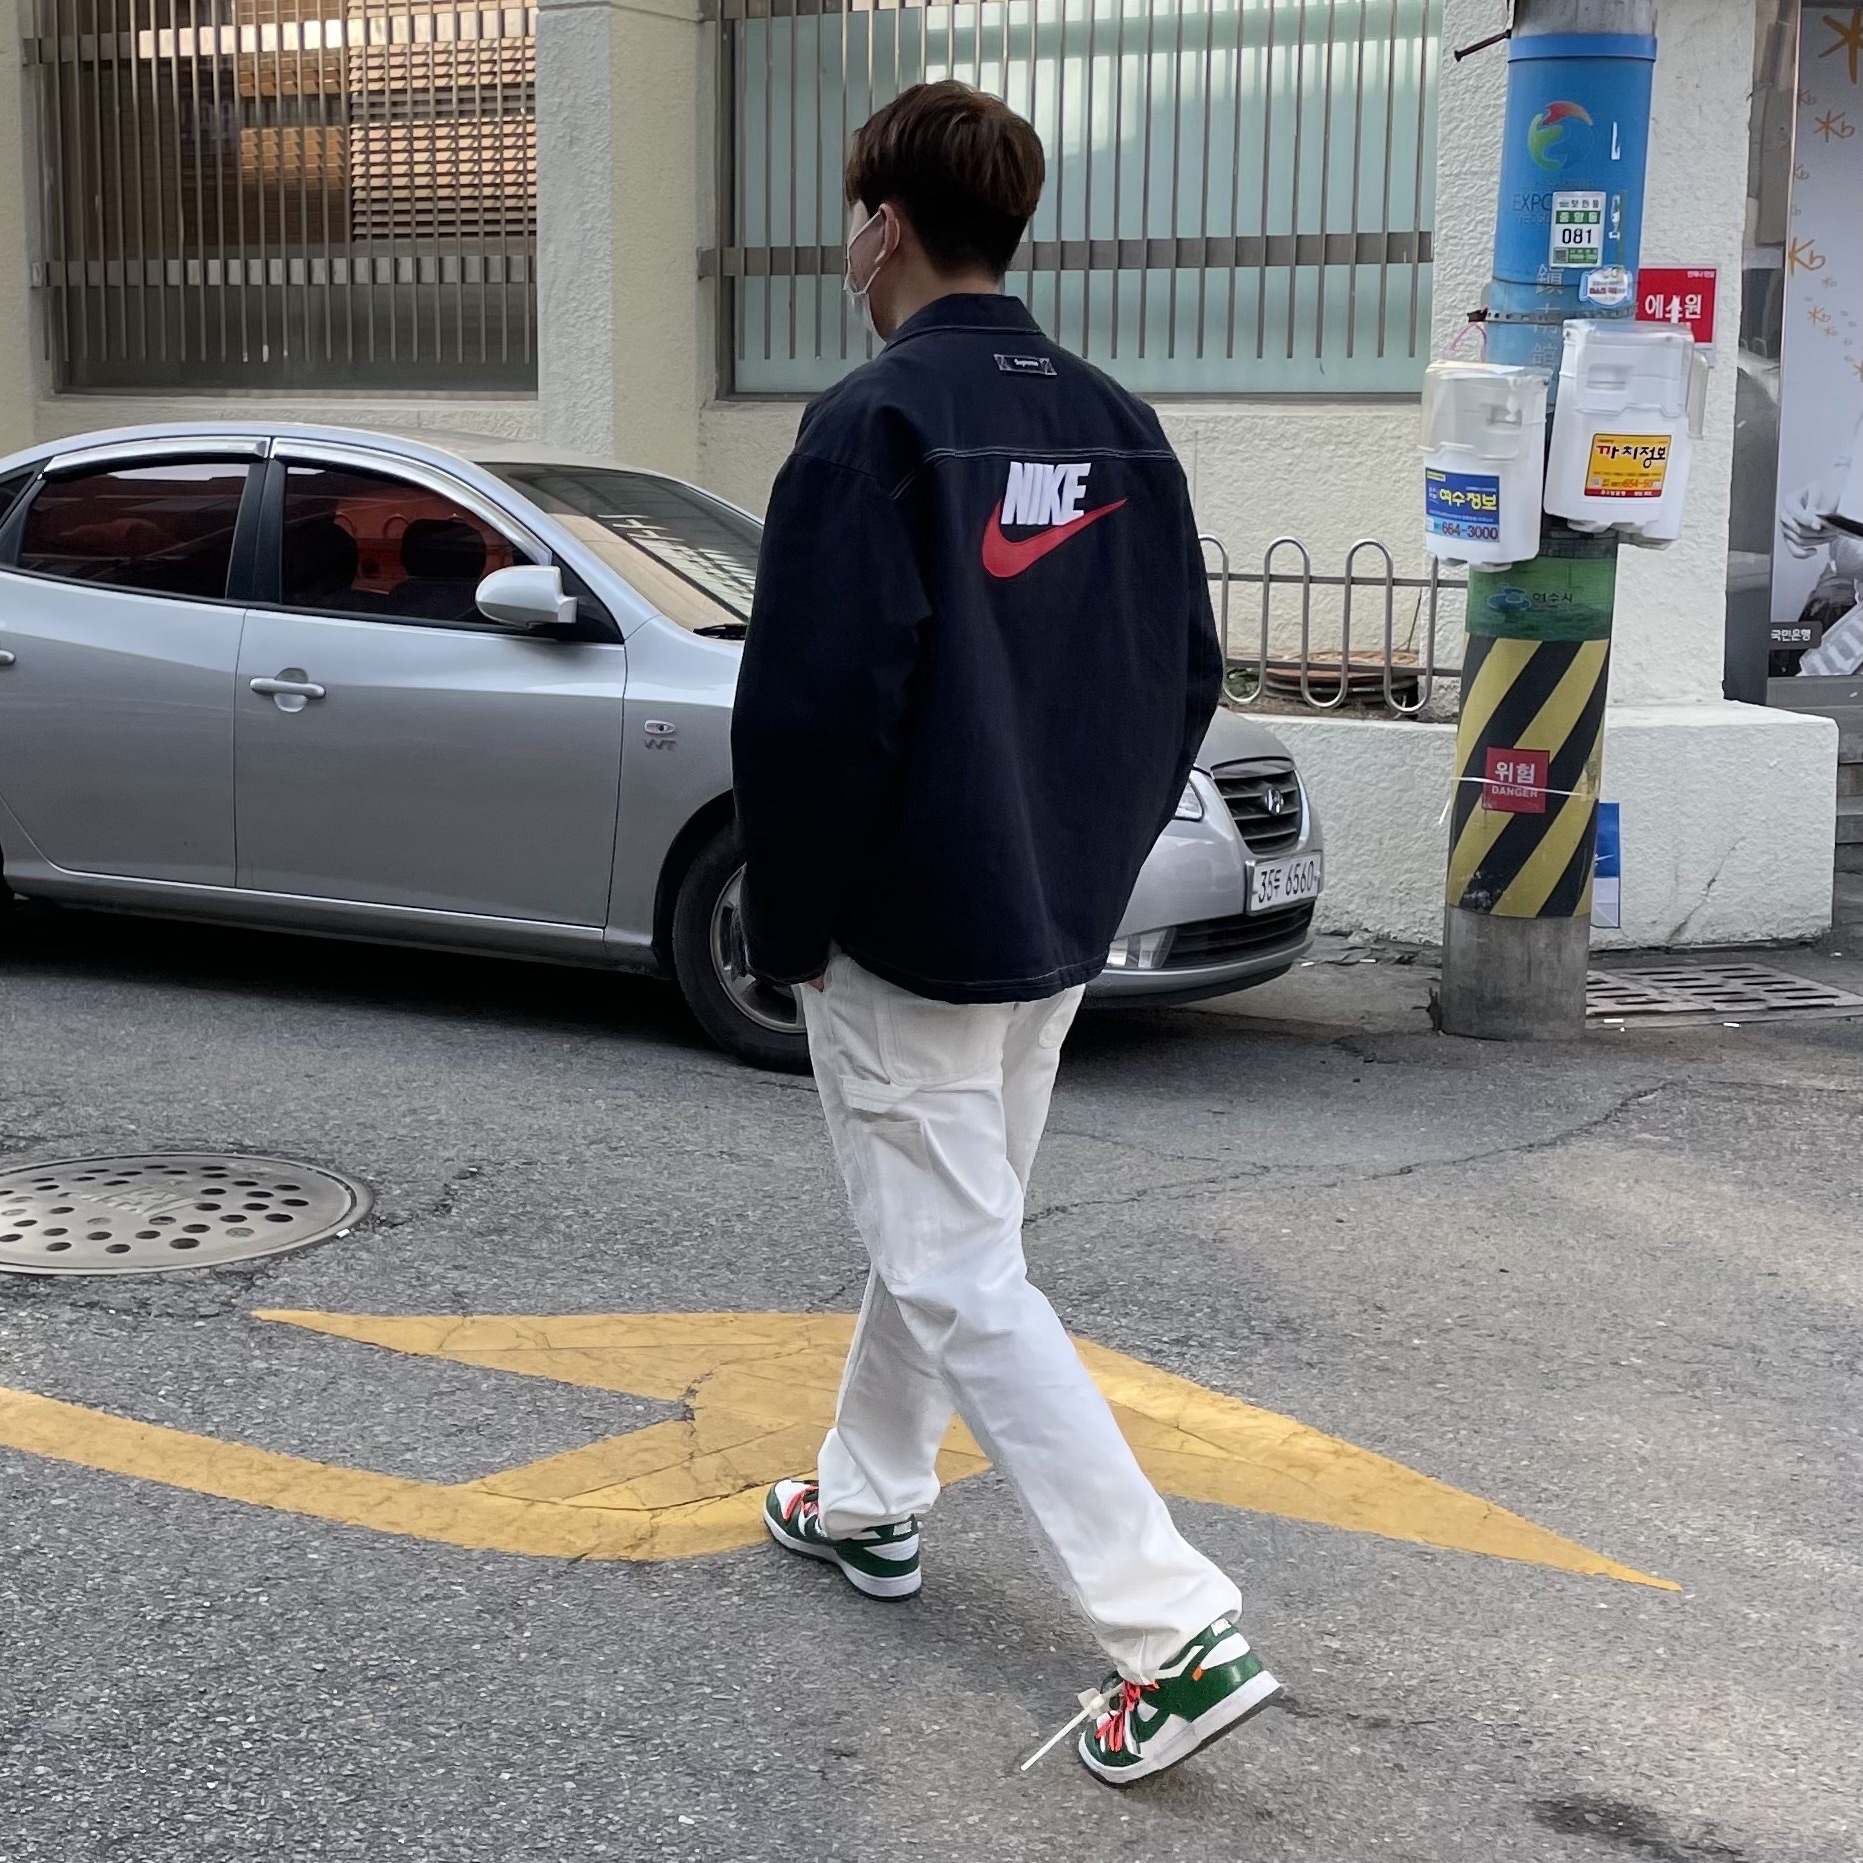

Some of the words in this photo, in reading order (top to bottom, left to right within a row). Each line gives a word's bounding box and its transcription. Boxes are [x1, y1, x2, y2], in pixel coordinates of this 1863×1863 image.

[1562, 228, 1592, 244] 081
[1596, 445, 1666, 469] 까치정보
[1001, 461, 1091, 526] NIKE
[1440, 488, 1497, 511] 여수정보
[1532, 592, 1574, 604] 여수시
[1771, 628, 1812, 642] 국민은행
[1494, 761, 1535, 784] 위험
[1491, 785, 1538, 798] DANGER
[1285, 860, 1315, 896] 6560
